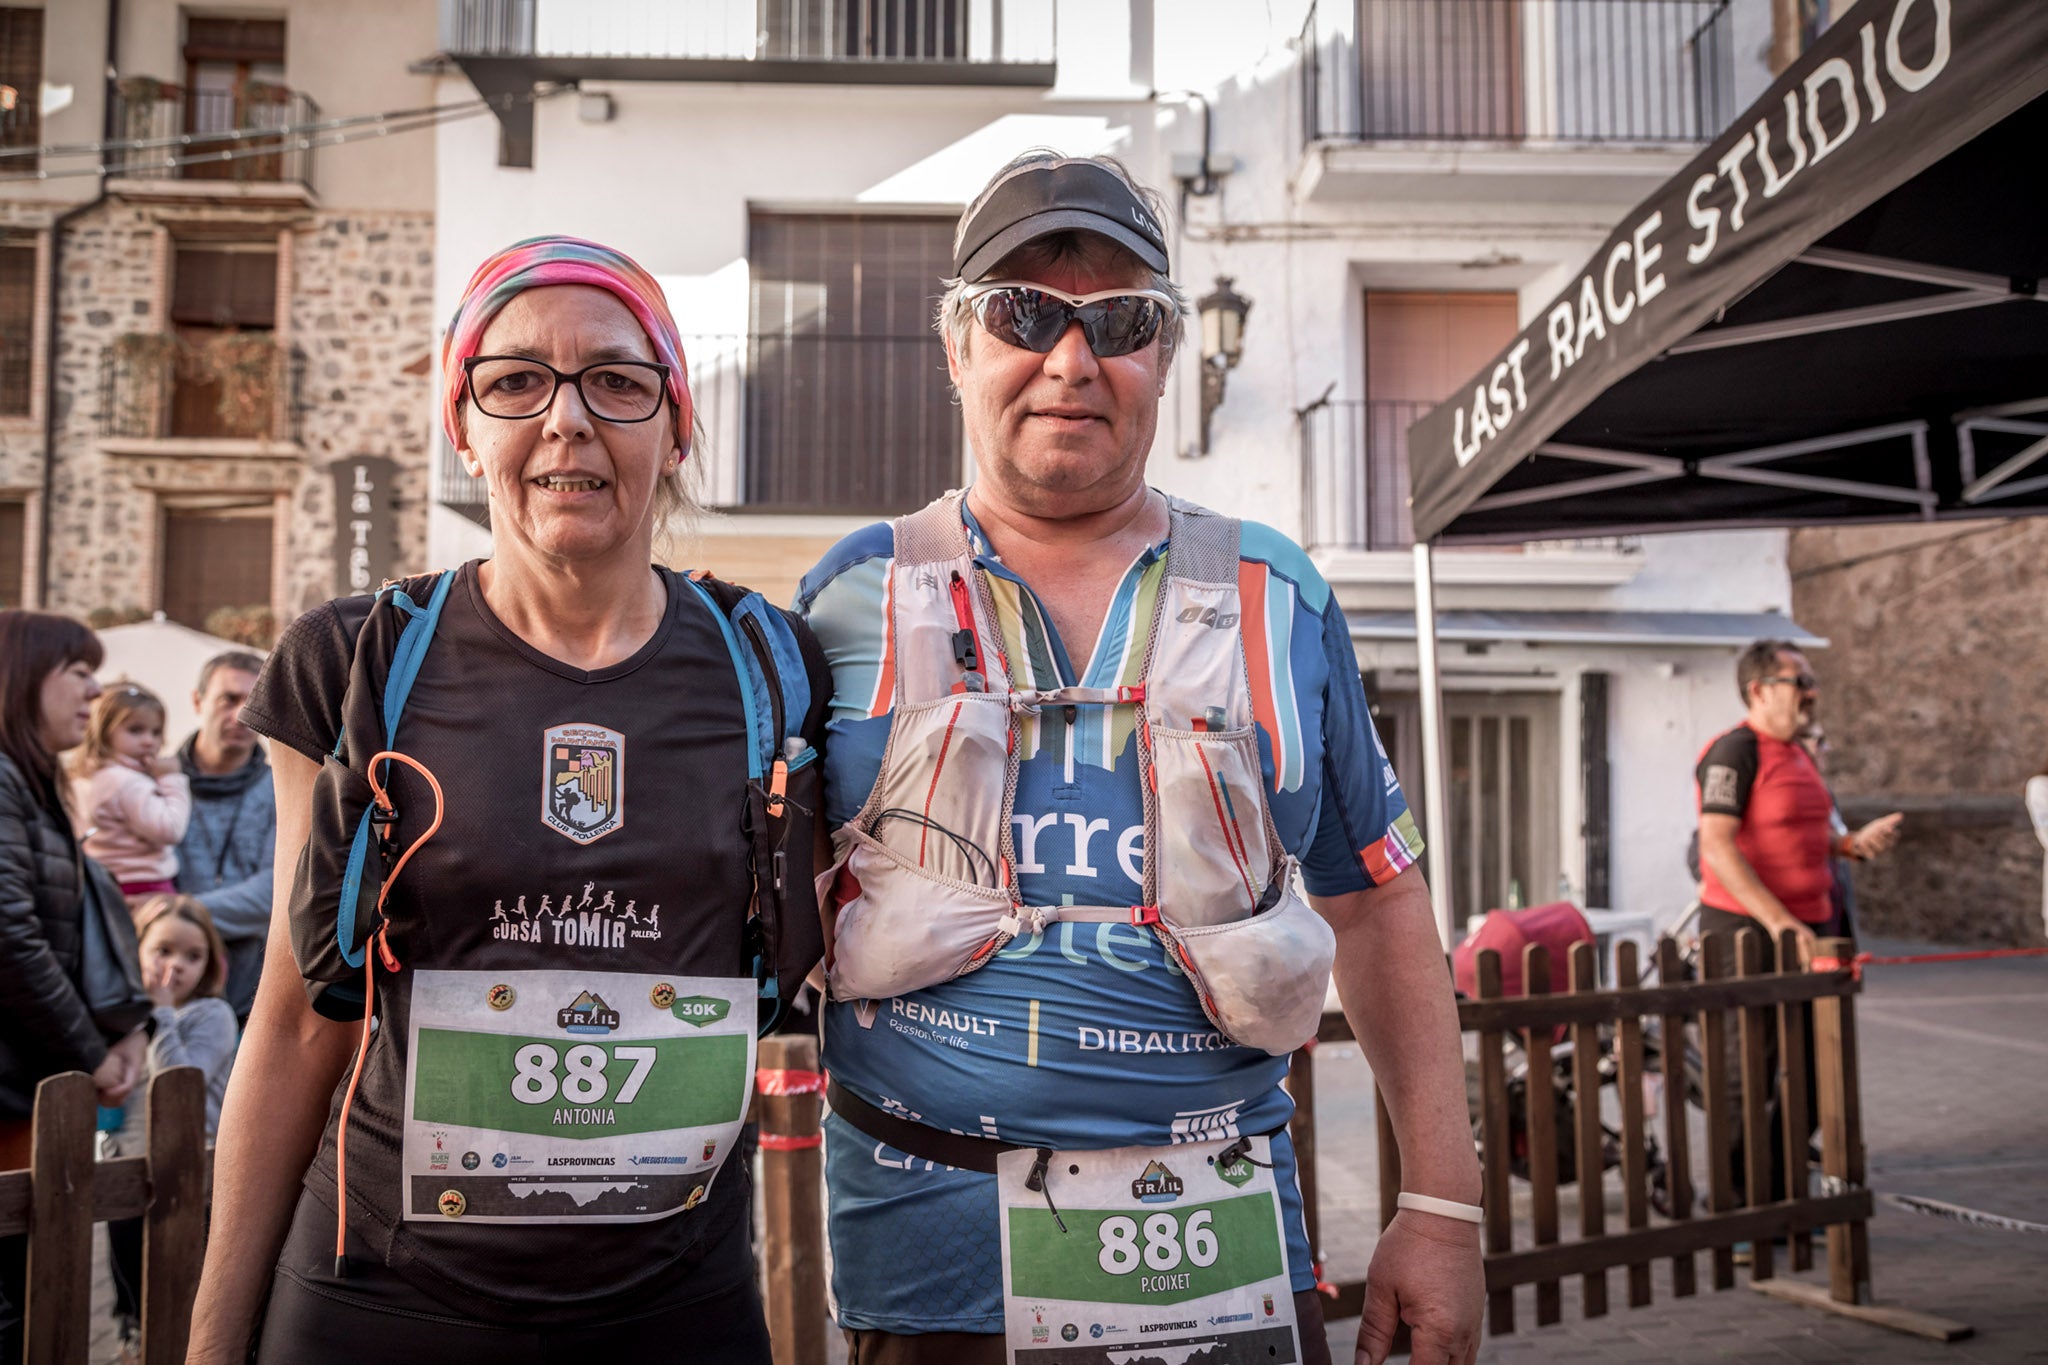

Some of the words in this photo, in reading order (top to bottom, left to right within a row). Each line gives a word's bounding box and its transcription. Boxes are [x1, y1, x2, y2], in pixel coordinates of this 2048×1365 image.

[1453, 338, 1529, 468] LAST
[1548, 211, 1667, 382] RACE
[1686, 0, 1951, 264] STUDIO
[548, 816, 570, 832] CLUB
[572, 820, 617, 839] POLLENÇA
[493, 919, 542, 943] CURSA
[552, 911, 626, 948] TOMIR
[682, 1002, 719, 1017] 30K
[892, 997, 1001, 1037] RENAULT
[889, 1018, 932, 1041] Passion
[949, 1035, 969, 1050] life
[510, 1043, 658, 1105] 887
[552, 1108, 616, 1125] ANTONIA
[547, 1157, 616, 1167] LASPROVINCIAS
[1098, 1209, 1219, 1275] 886
[1141, 1273, 1191, 1293] P.COIXET
[1139, 1320, 1198, 1334] LASPROVINCIAS
